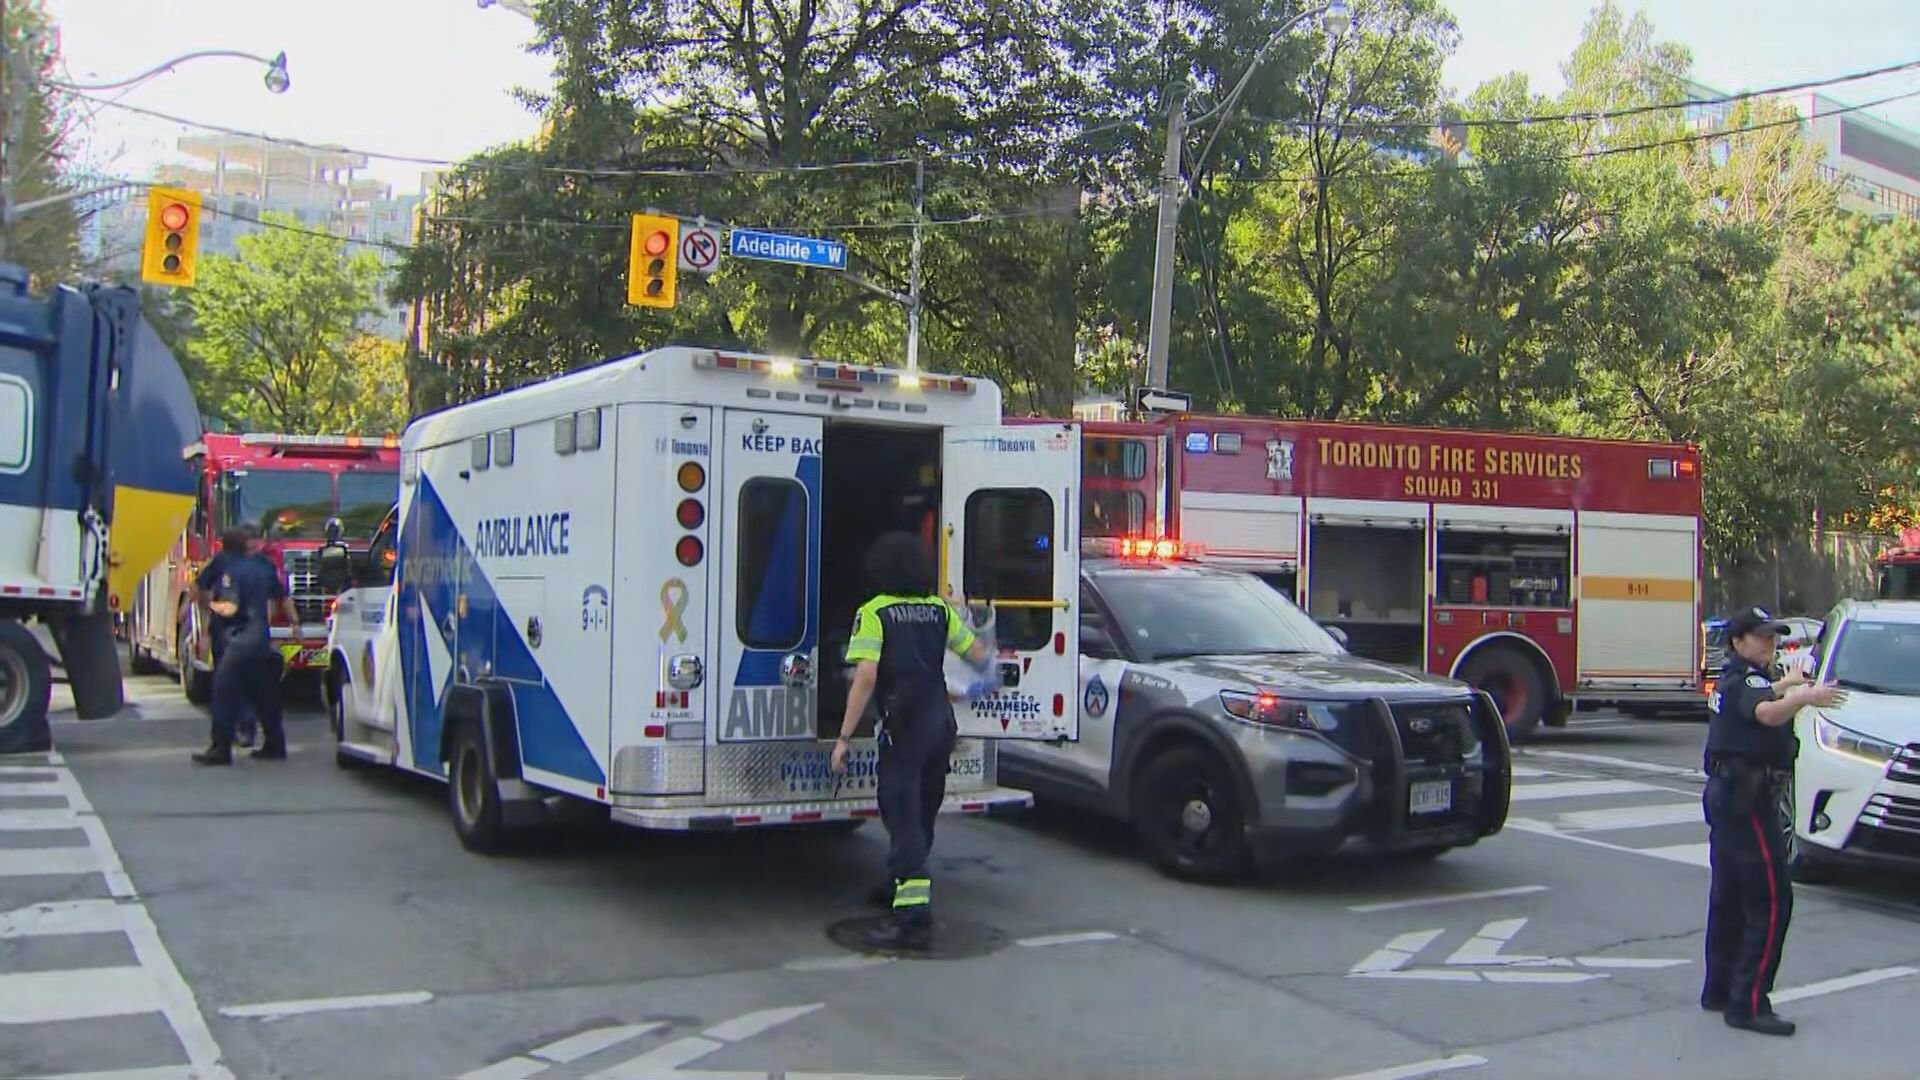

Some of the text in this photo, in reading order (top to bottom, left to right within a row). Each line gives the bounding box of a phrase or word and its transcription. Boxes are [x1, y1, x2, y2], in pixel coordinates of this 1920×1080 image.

[737, 235, 811, 260] Adelaide
[828, 246, 842, 264] W
[742, 435, 785, 452] KEEP
[1318, 438, 1582, 479] TORONTO FIRE SERVICES
[1404, 476, 1499, 499] SQUAD 331
[474, 512, 570, 558] AMBULANCE
[888, 605, 938, 623] PARAMEDIC
[971, 701, 1041, 712] PARAMEDIC
[781, 760, 880, 781] PARAEDIC
